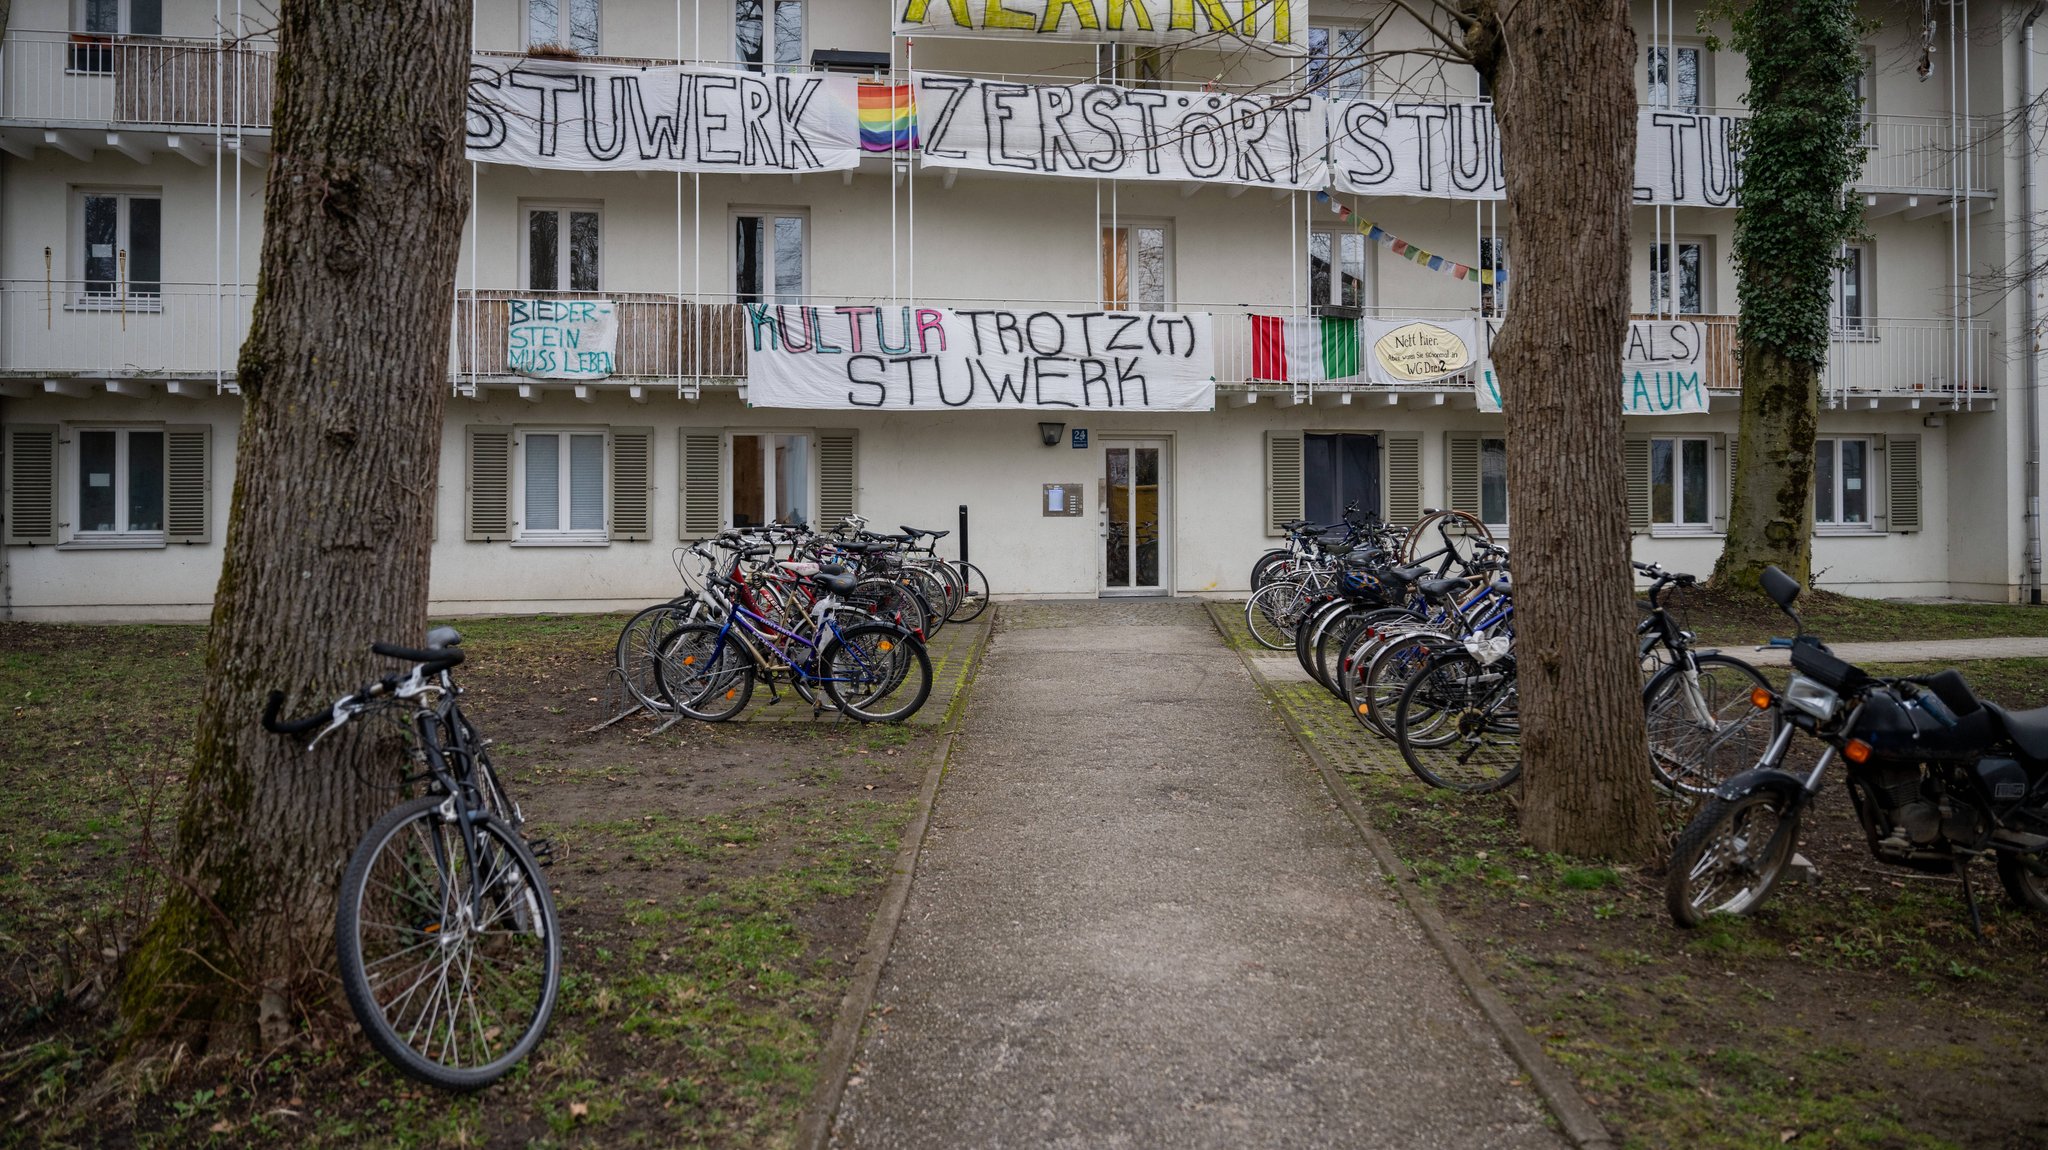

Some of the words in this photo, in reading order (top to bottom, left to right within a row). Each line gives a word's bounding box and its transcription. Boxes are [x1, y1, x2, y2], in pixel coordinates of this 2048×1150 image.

[466, 63, 823, 170] STUWERK
[921, 77, 1312, 184] ZERSTÖRT
[1344, 101, 1506, 192] STU
[1633, 114, 1746, 206] TU
[509, 300, 611, 325] BIEDER-
[747, 302, 946, 355] KULTUR
[955, 310, 1195, 357] TROTZ(T)
[510, 326, 580, 349] STEIN
[1395, 334, 1417, 349] Nett
[1419, 331, 1439, 346] hier.
[1622, 321, 1701, 364] ALS)
[509, 350, 556, 373] MUSS
[564, 351, 614, 374] LEBEN
[1406, 361, 1423, 375] WG
[847, 355, 1149, 408] STUWERK
[1074, 430, 1086, 441] 24
